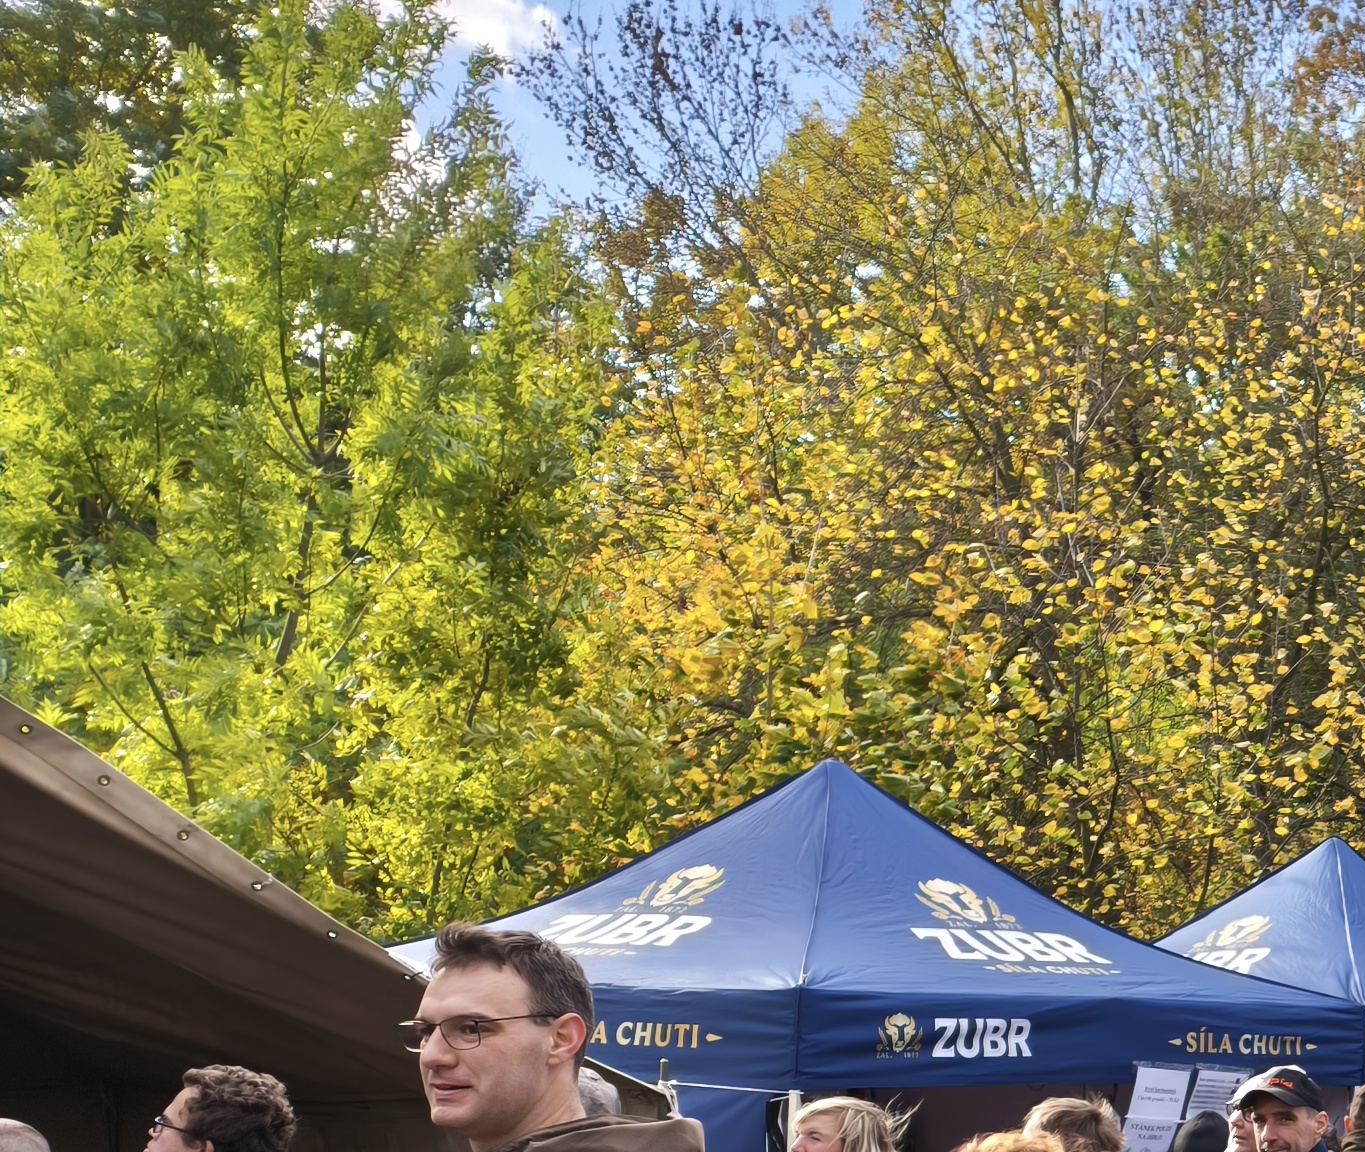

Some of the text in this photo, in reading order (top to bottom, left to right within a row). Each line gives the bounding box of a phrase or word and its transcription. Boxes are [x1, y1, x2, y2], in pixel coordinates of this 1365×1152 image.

[537, 913, 713, 947] ZUBR
[909, 927, 1114, 965] ZUBR
[615, 1020, 700, 1050] CHUTI
[931, 1017, 1034, 1059] ZUBR
[1186, 1026, 1303, 1056] SÍLA CHUTI
